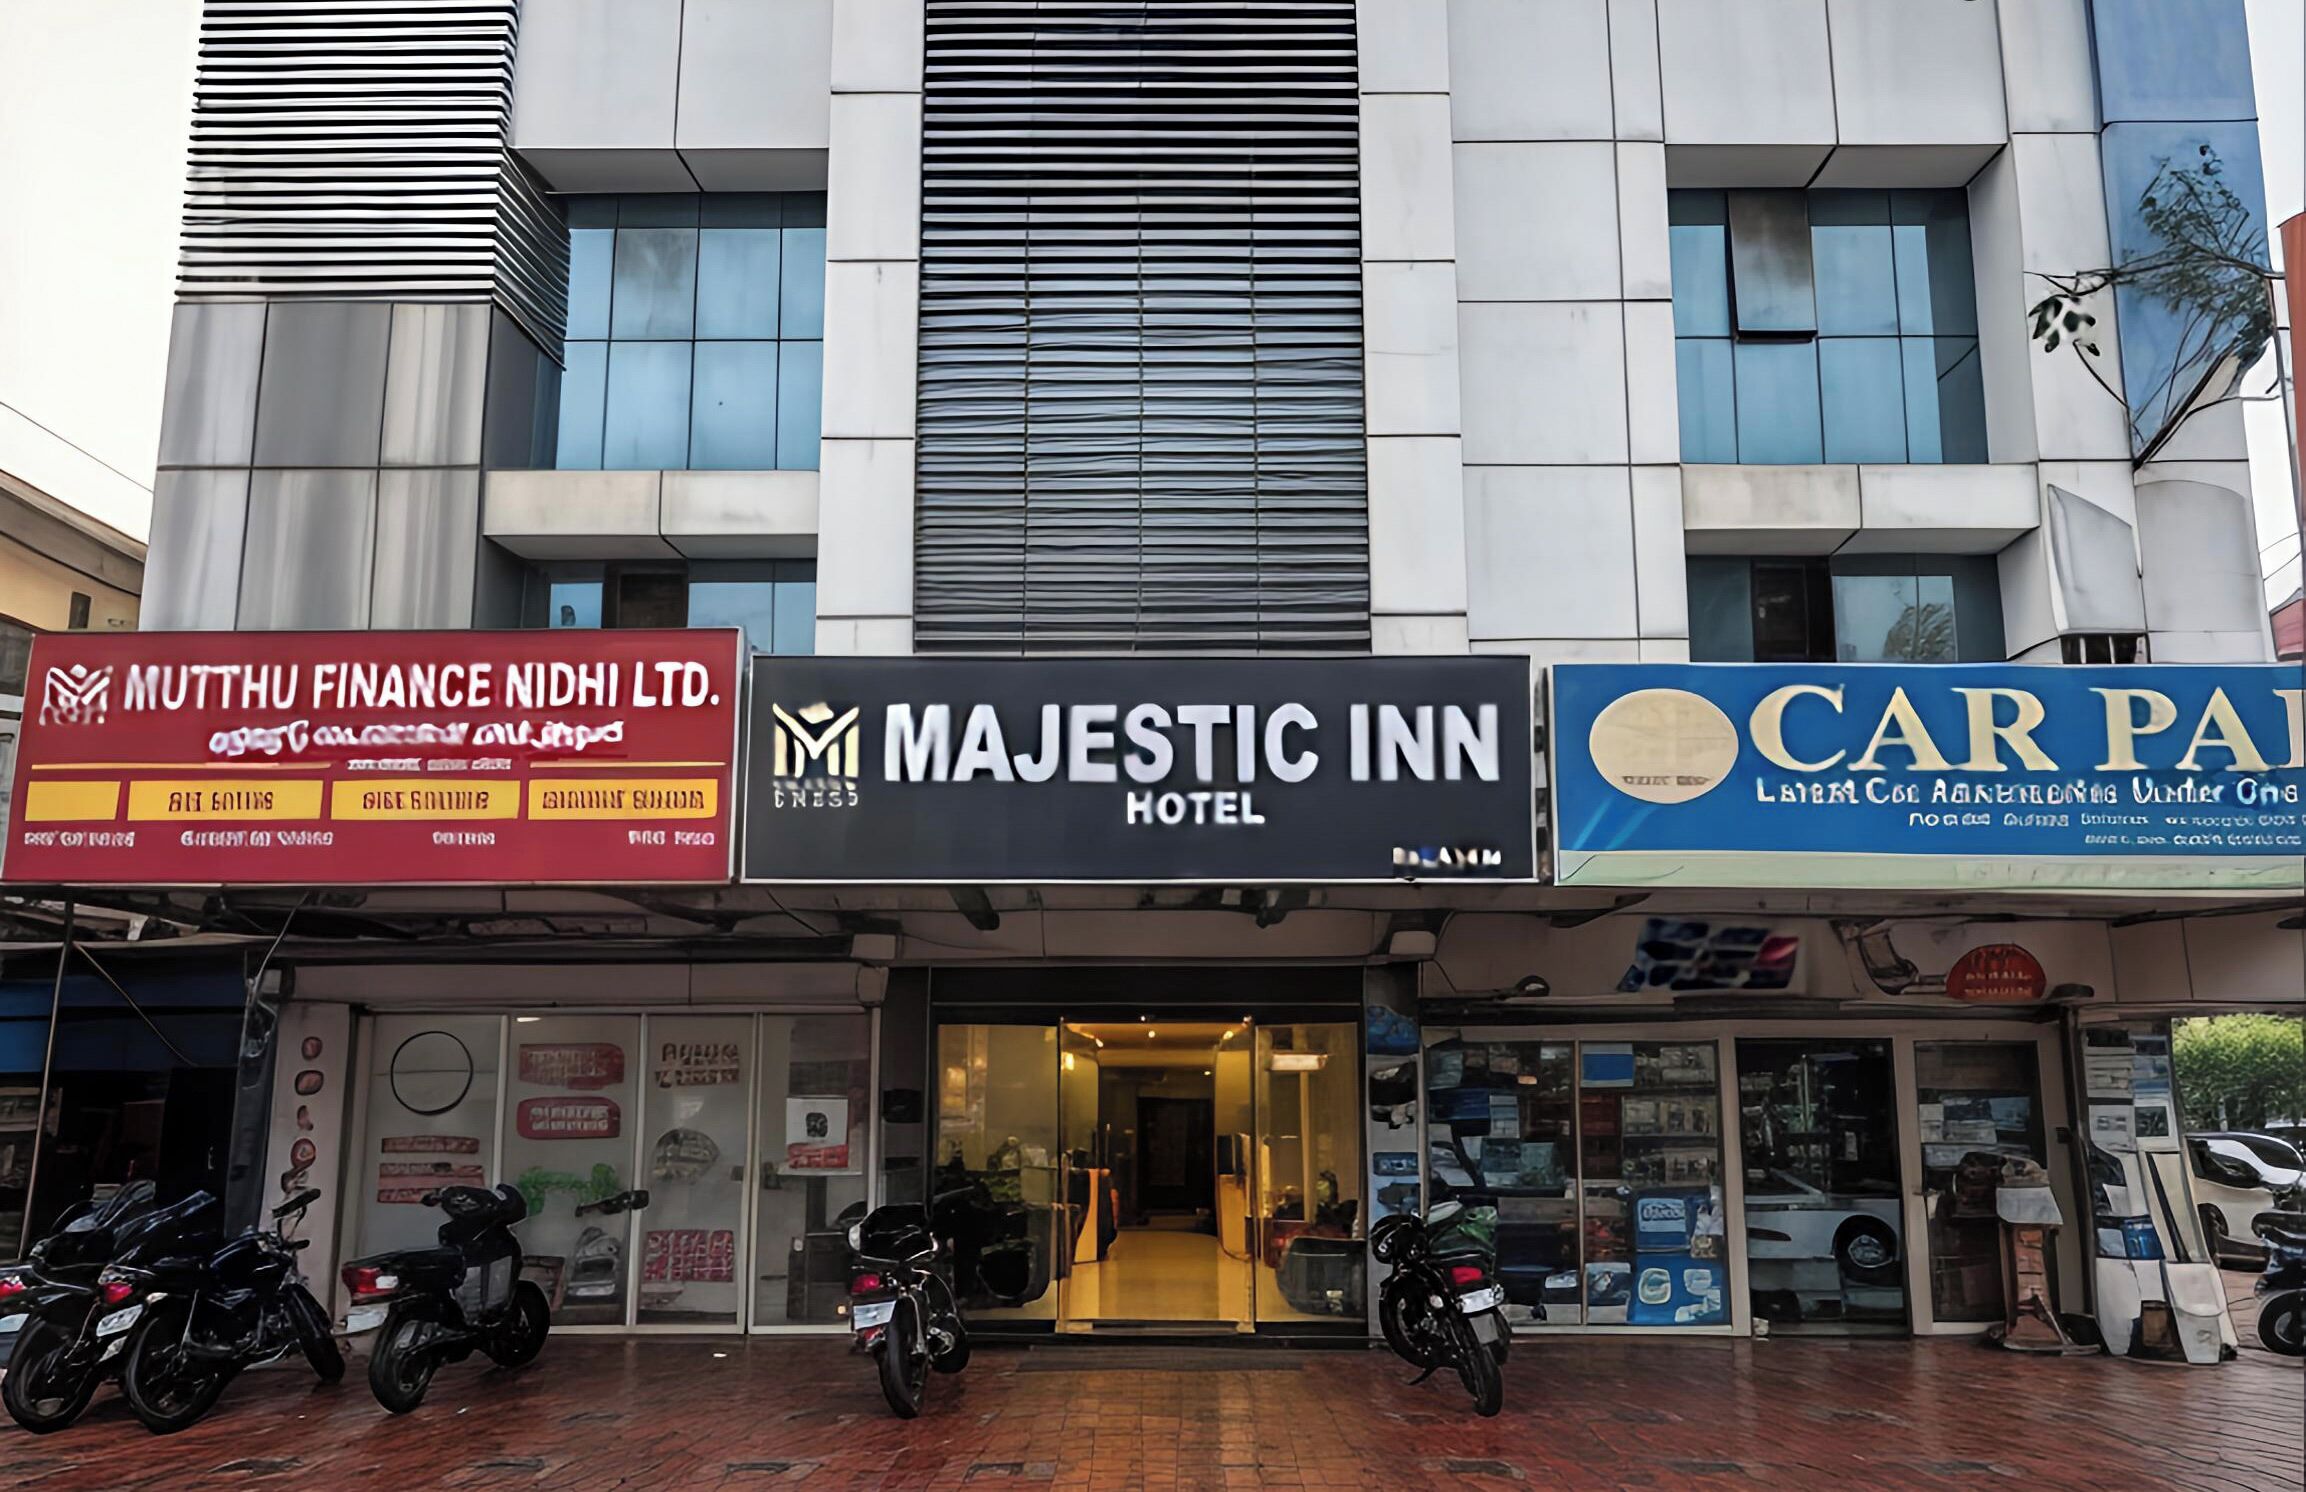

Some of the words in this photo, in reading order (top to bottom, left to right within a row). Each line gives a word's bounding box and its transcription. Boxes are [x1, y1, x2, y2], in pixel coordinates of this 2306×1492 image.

[124, 664, 298, 711] MUTTHU
[313, 662, 492, 709] FINANCE
[506, 662, 618, 708] NIDHI
[633, 661, 719, 707] LTD.
[885, 703, 1318, 782] MAJESTIC
[1351, 704, 1499, 781] INN
[1750, 685, 2059, 771] CAR
[1127, 792, 1265, 824] HOTEL
